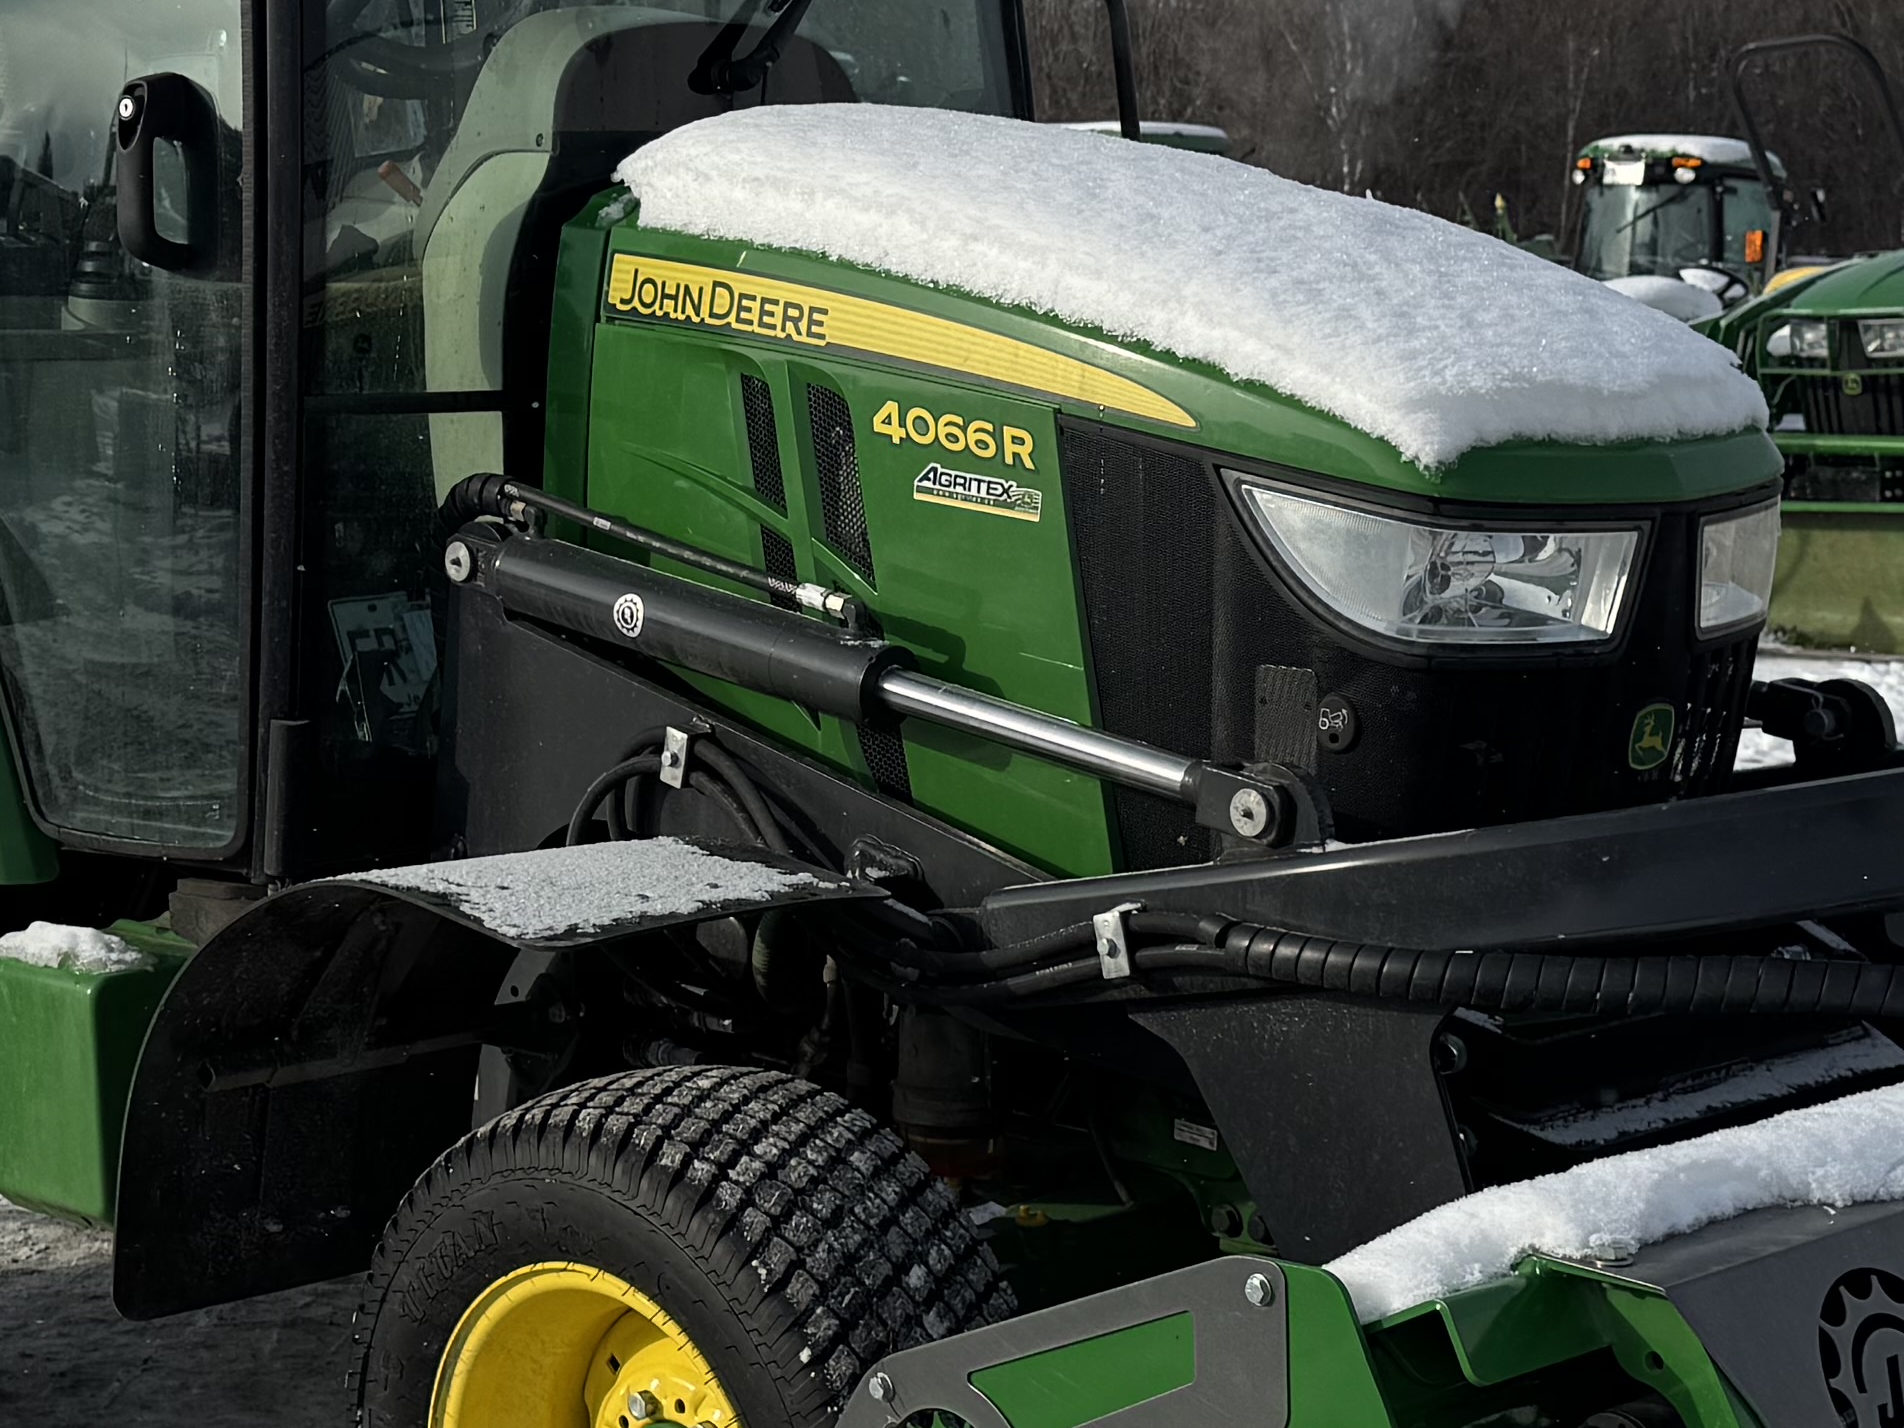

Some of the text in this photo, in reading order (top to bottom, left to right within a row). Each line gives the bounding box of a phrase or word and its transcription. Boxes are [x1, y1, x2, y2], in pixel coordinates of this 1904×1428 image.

[619, 268, 830, 341] JOHN DEERE
[917, 466, 1014, 500] AGRITEX
